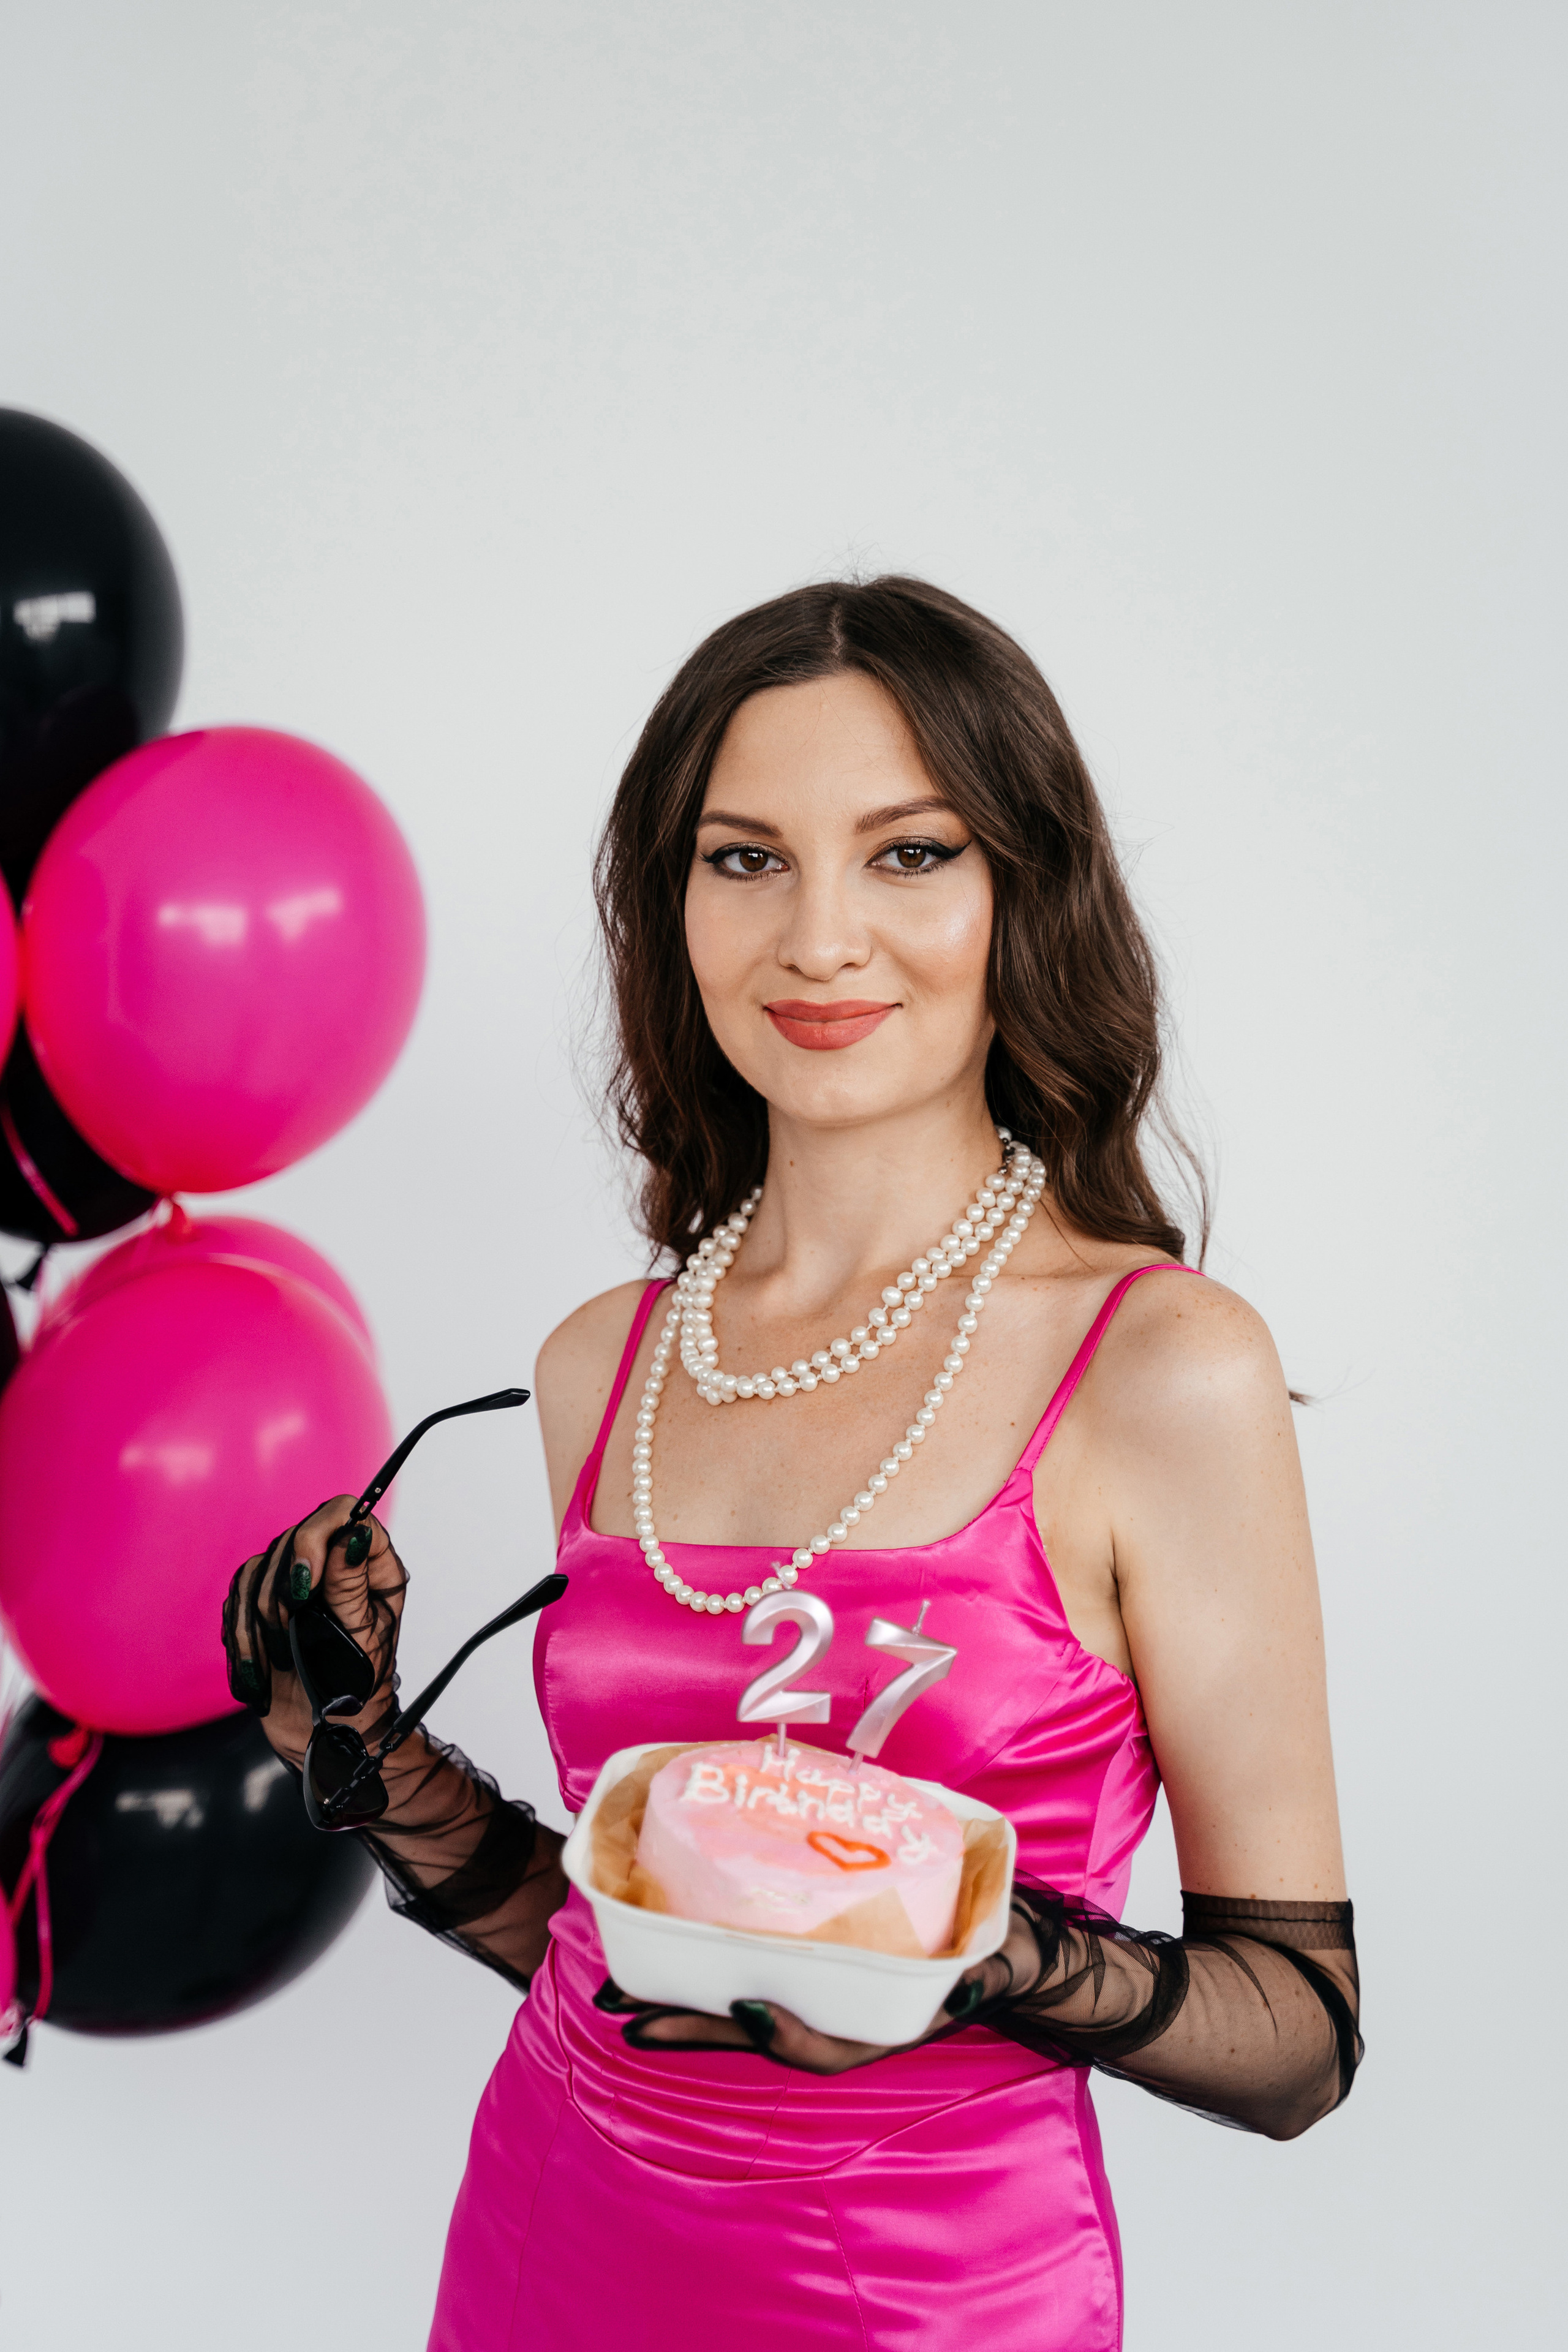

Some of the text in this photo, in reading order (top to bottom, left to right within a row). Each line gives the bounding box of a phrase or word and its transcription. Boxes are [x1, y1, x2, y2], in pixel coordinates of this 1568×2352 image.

[737, 1590, 958, 1758] 27
[679, 1762, 937, 1864] Birthday
[760, 1745, 923, 1820] Happy
